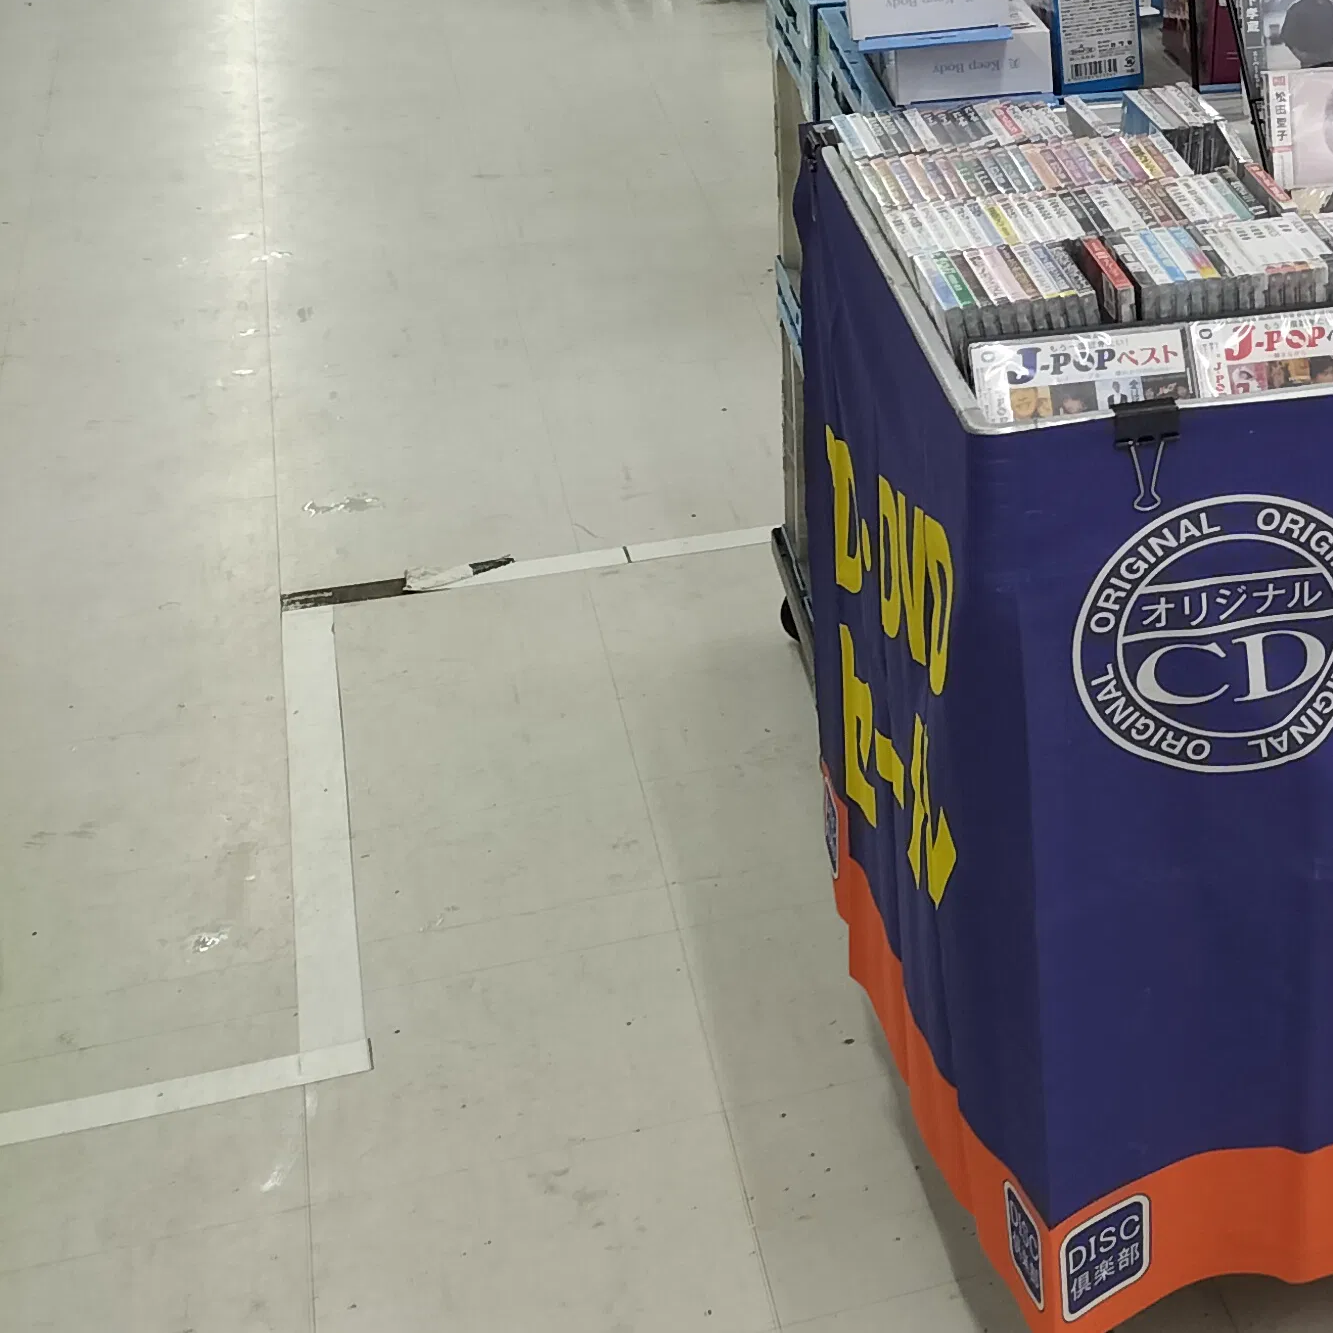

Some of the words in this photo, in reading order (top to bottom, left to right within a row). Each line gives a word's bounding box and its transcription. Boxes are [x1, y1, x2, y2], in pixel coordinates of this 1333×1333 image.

[824, 423, 954, 697] D・DVD
[1090, 511, 1222, 634] ORIGINAL
[1141, 580, 1323, 629] オリジナル
[1136, 630, 1327, 705] CD
[1090, 662, 1212, 761] ORIGINAL
[838, 622, 957, 911] セール
[1068, 1214, 1141, 1275] DISC
[1070, 1242, 1141, 1302] 倶楽部
